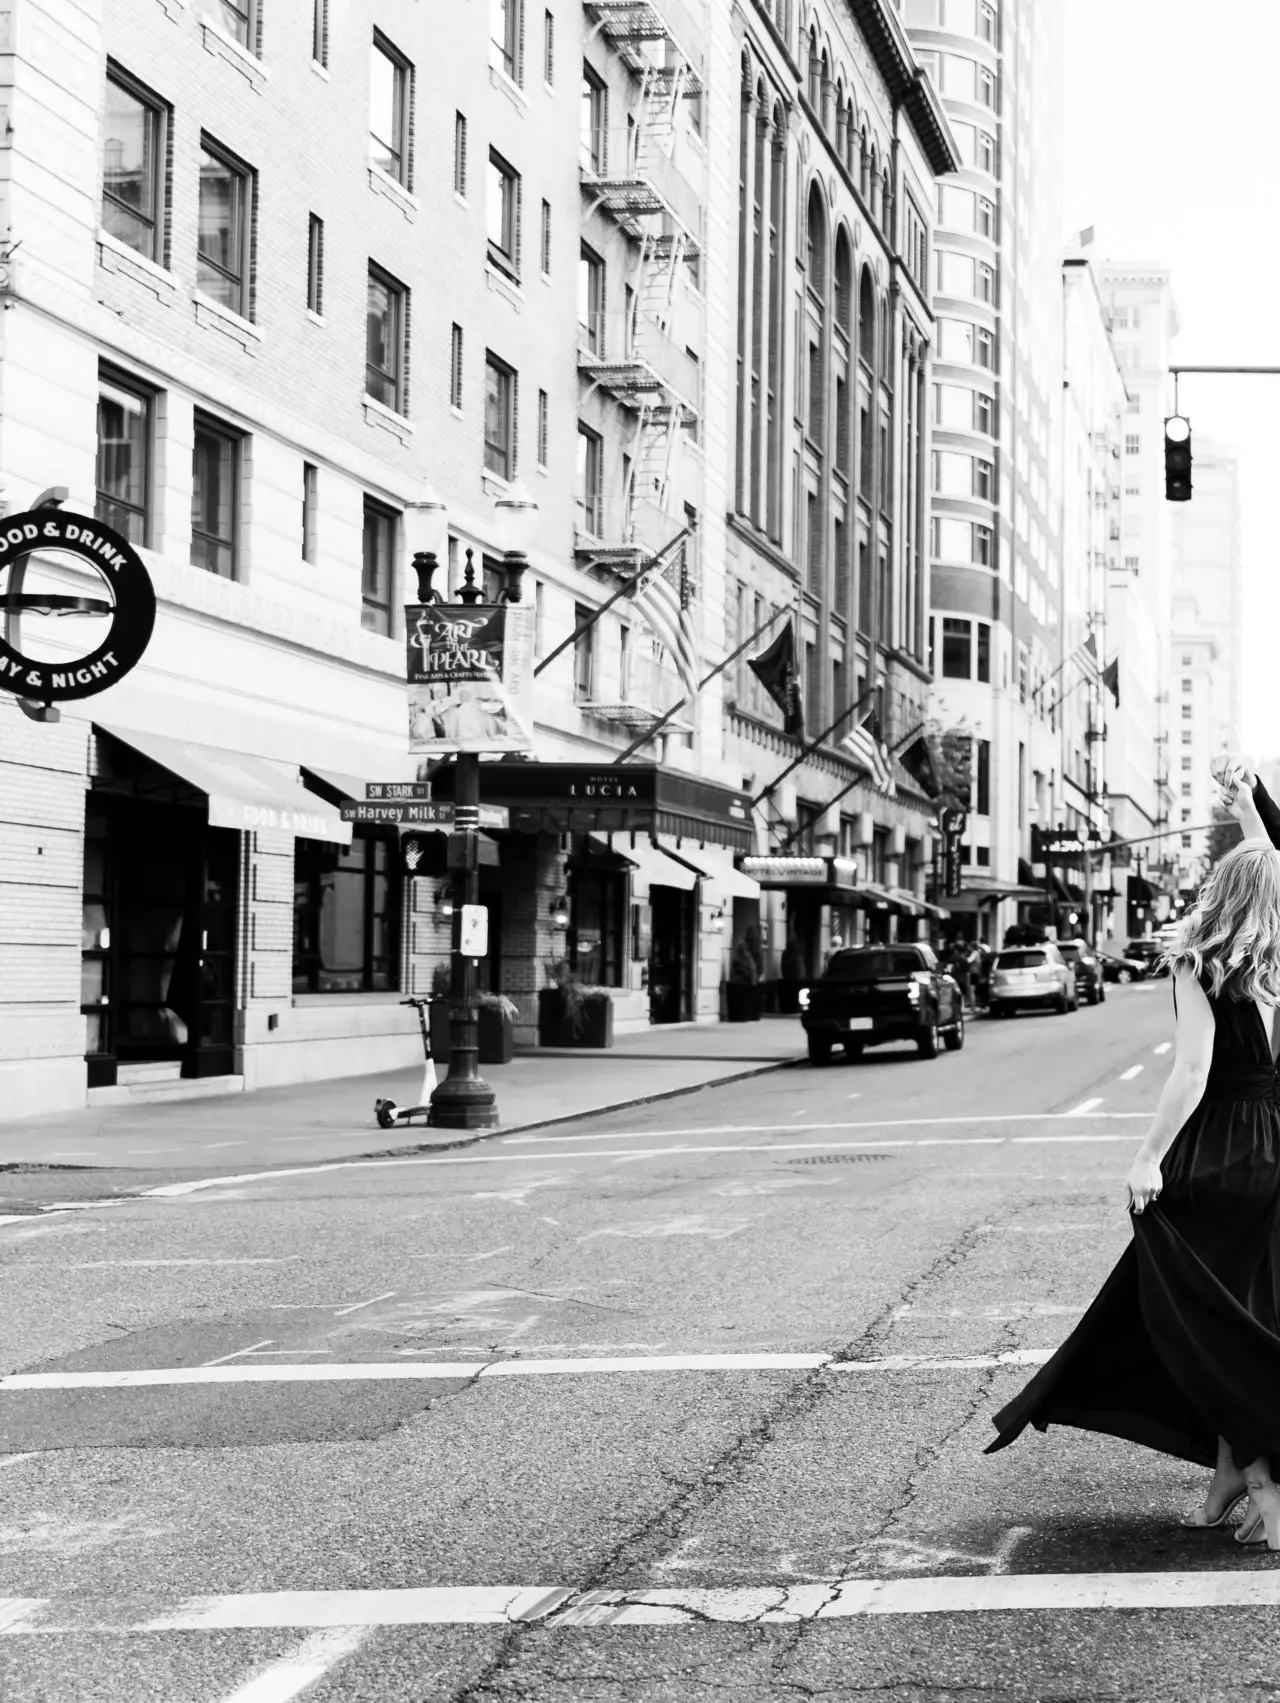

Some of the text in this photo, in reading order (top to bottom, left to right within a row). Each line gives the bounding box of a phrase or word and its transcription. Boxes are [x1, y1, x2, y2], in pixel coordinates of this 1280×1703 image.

[0, 522, 128, 571] OOD & DRINK
[434, 617, 489, 641] ART
[0, 651, 119, 688] AY & NIGHT
[369, 785, 382, 798] SW
[386, 784, 414, 798] STARK
[570, 784, 637, 796] LUCIA
[243, 805, 278, 828] FOOD
[357, 805, 404, 823] Harvey
[408, 806, 436, 820] Milk
